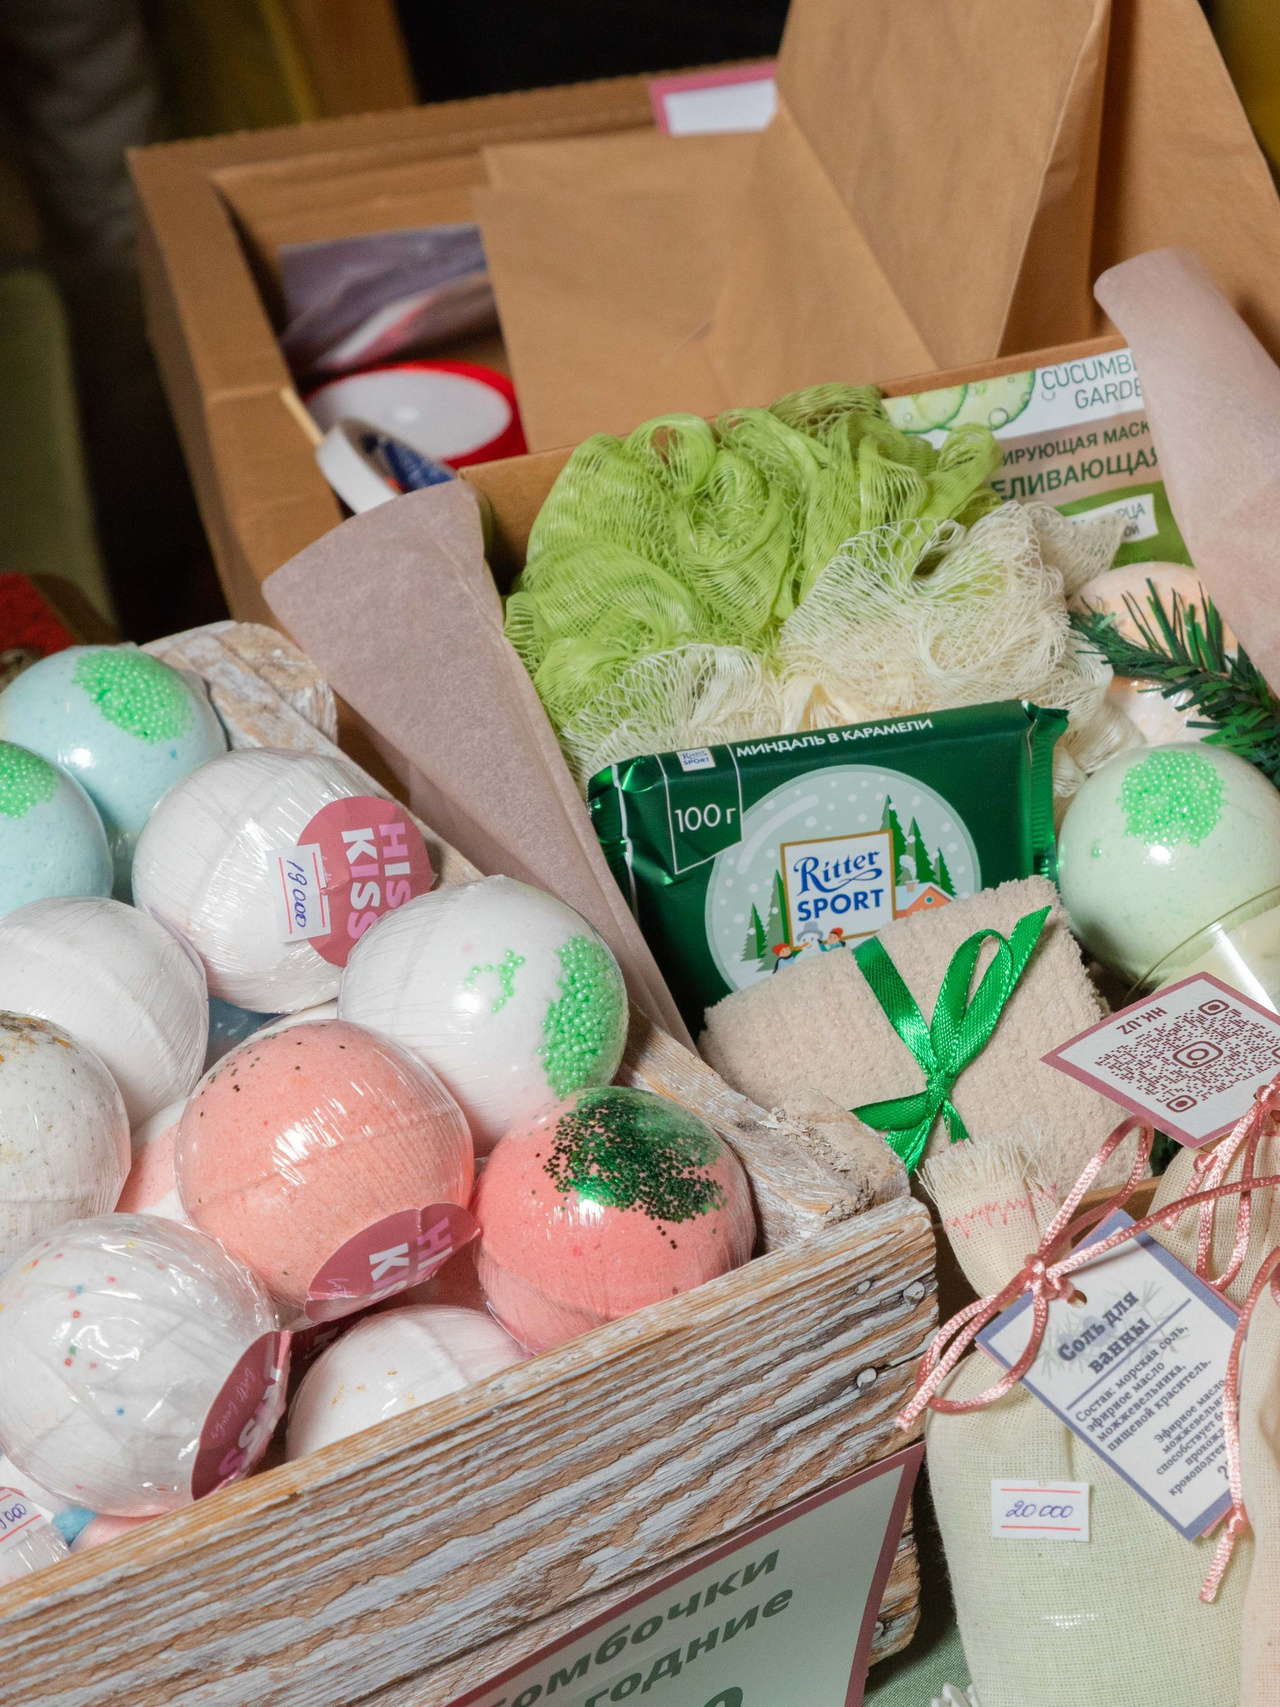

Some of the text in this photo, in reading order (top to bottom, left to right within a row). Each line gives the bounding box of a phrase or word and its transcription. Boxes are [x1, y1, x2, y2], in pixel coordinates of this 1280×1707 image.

[737, 718, 934, 758] МИНДАЛЬ В КАРАМЕЛИ
[674, 803, 737, 833] 100 г
[341, 827, 381, 940] KISS
[793, 849, 883, 897] Ritter
[797, 888, 884, 922] SPORT
[1121, 1006, 1168, 1035] HK.UZ
[1057, 1291, 1139, 1361] Соль для
[1088, 1318, 1151, 1374] ванны
[1075, 1325, 1189, 1422] Состав: морская соль,
[1086, 1362, 1165, 1432] эфирное масло
[1097, 1363, 1187, 1442] можжевельника,
[1107, 1359, 1211, 1451] пищевой краситель.
[1154, 1379, 1225, 1443] Эфирное масло
[1156, 1421, 1216, 1475] способствует
[490, 1549, 781, 1707] омбочки
